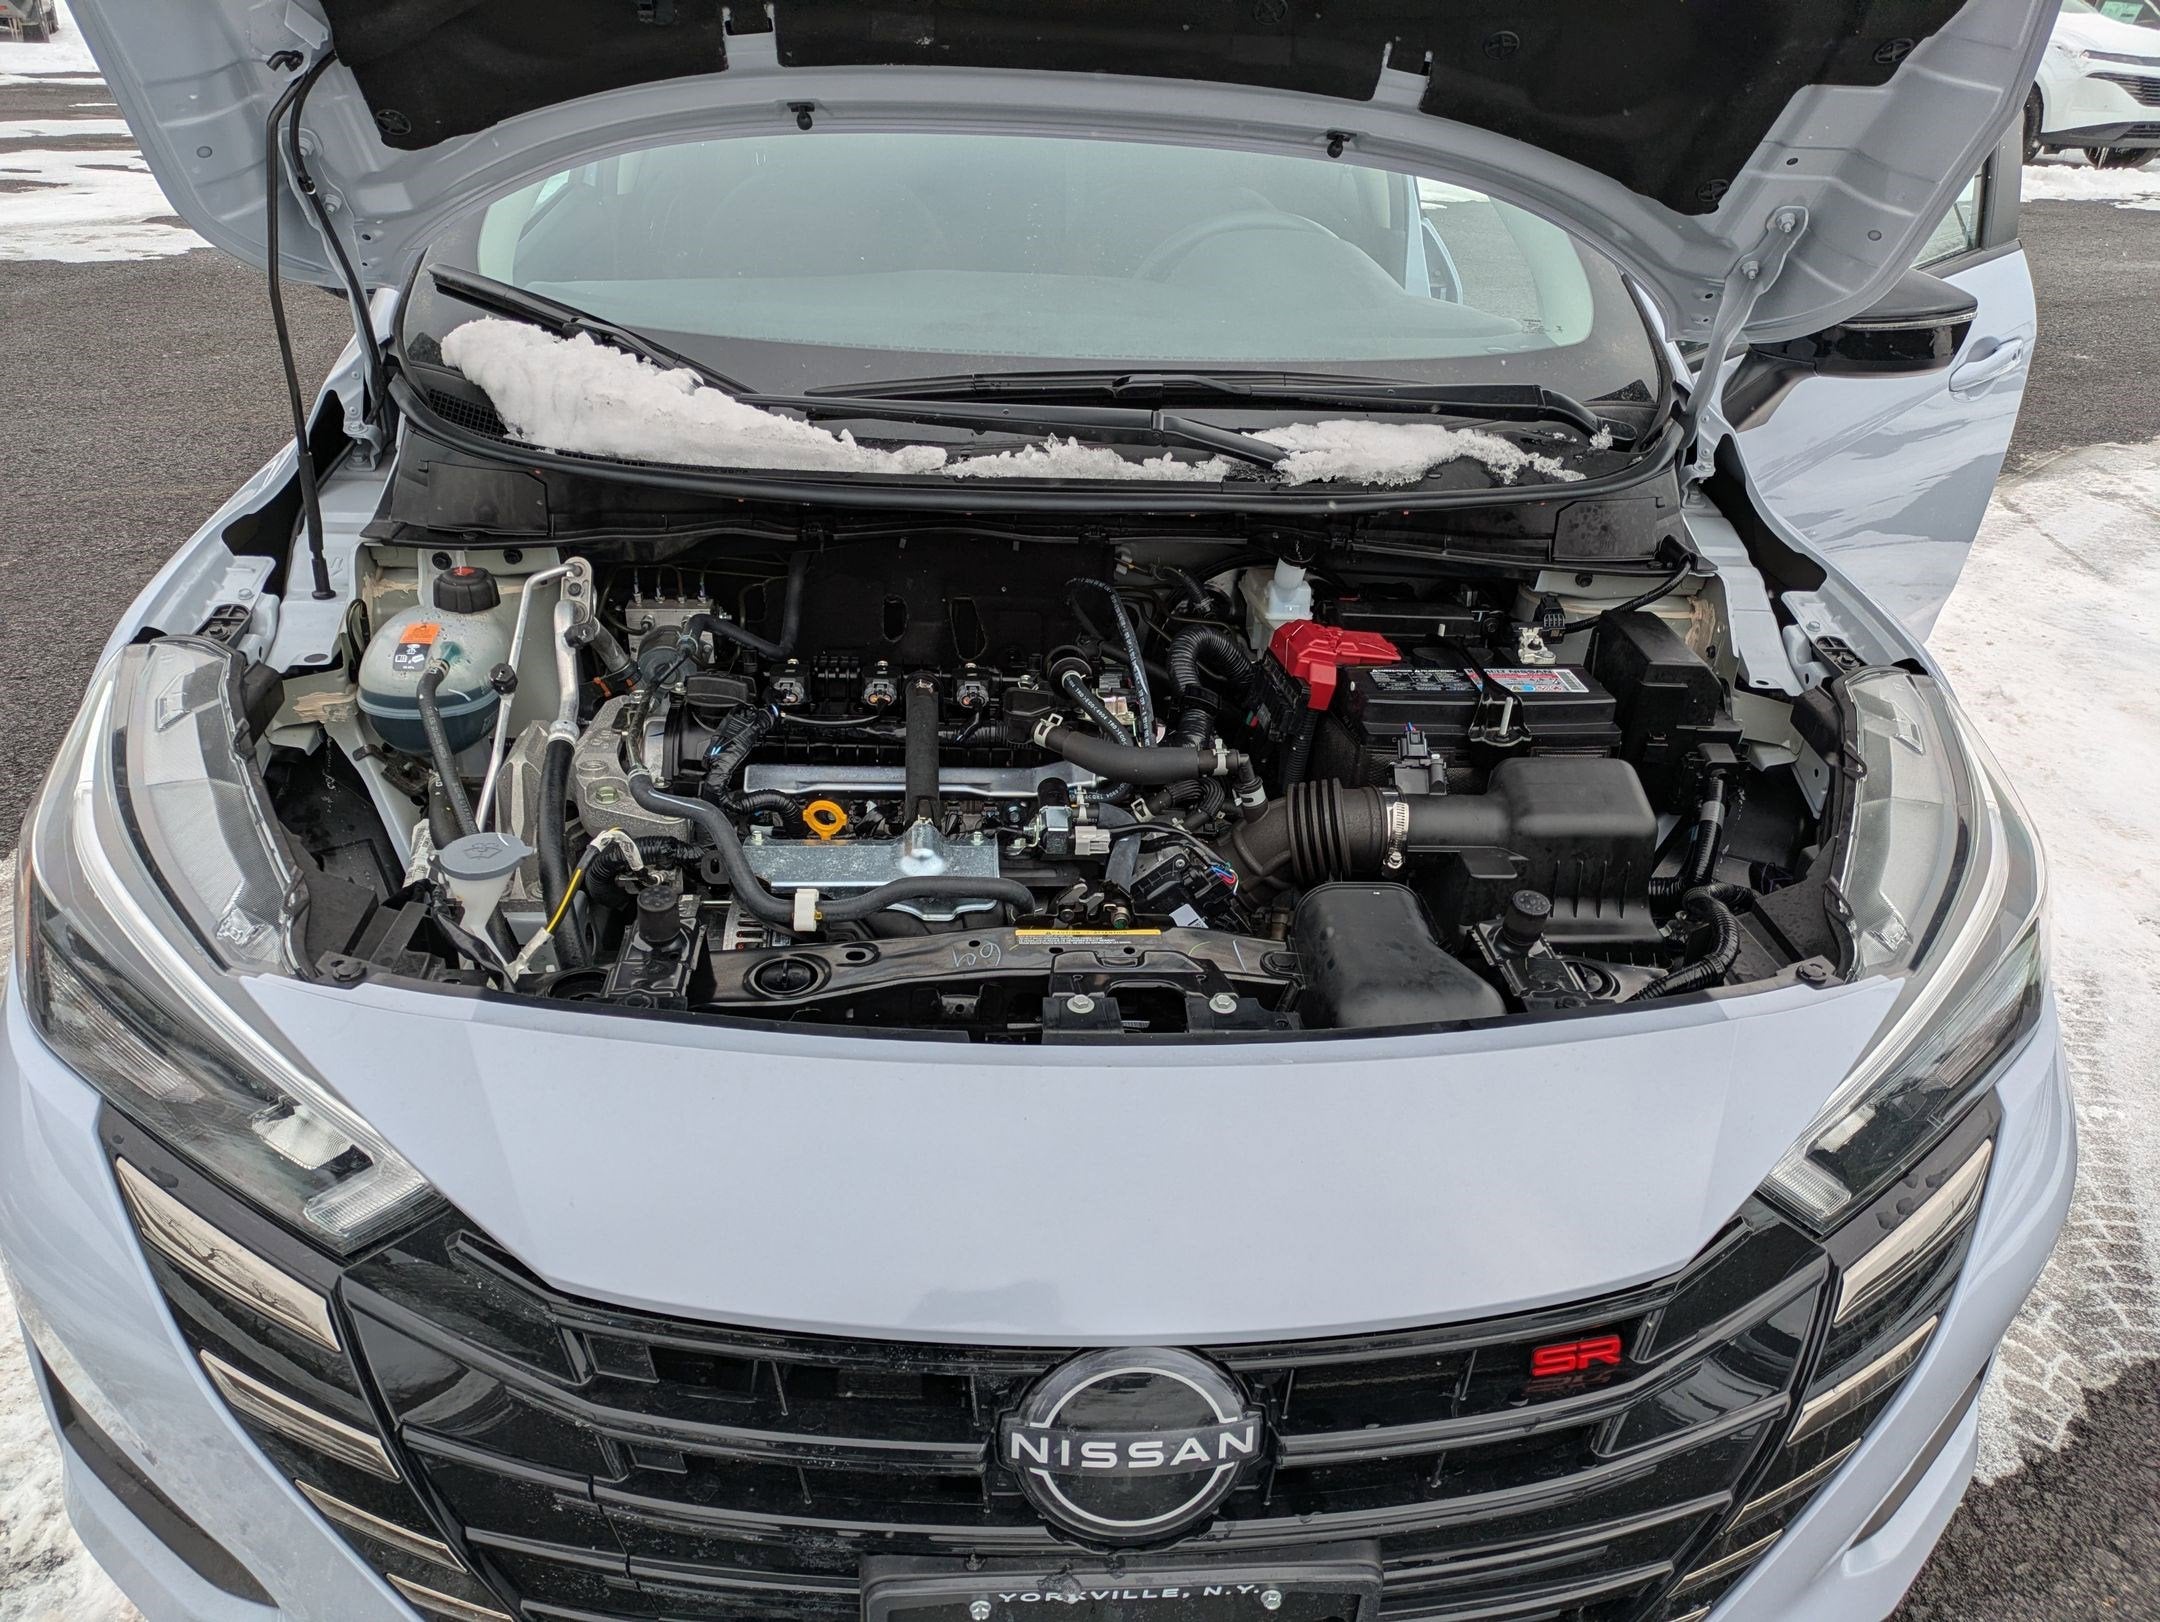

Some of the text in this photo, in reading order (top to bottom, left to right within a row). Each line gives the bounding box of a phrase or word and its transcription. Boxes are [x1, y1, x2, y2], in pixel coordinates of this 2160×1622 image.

[1531, 1334, 1621, 1377] SR
[1011, 1426, 1254, 1469] NISSAN
[1202, 1584, 1260, 1597] N.Y.
